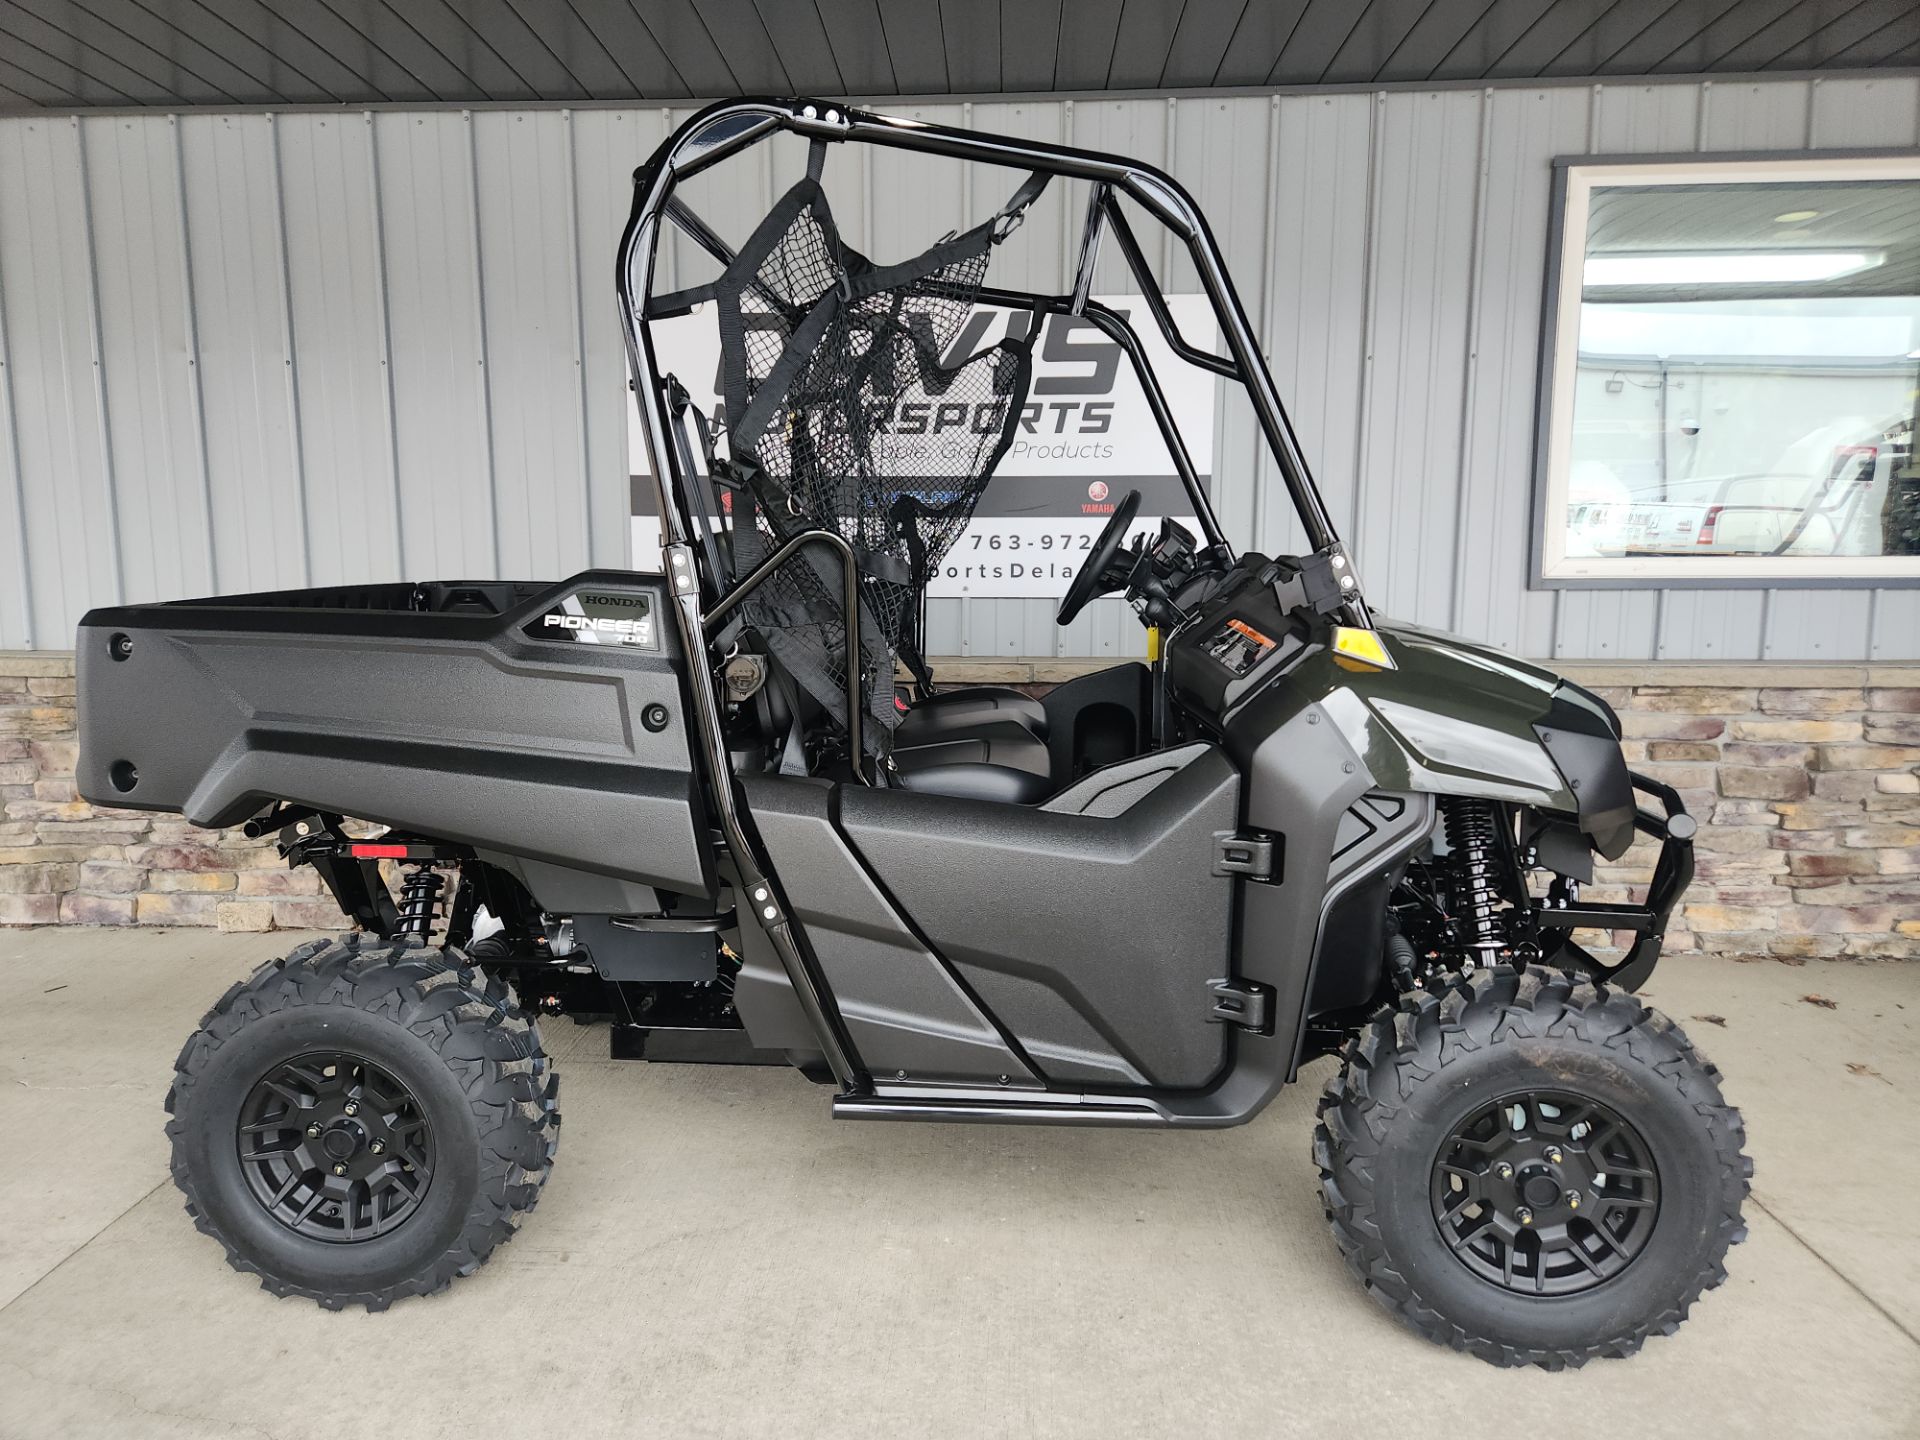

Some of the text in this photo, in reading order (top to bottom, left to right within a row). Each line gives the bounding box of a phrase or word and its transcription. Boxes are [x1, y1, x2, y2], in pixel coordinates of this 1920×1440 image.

[1013, 440, 1113, 459] Products
[1082, 503, 1116, 514] YAMAHA
[584, 595, 646, 609] HONDA
[543, 614, 650, 635] PIONEER
